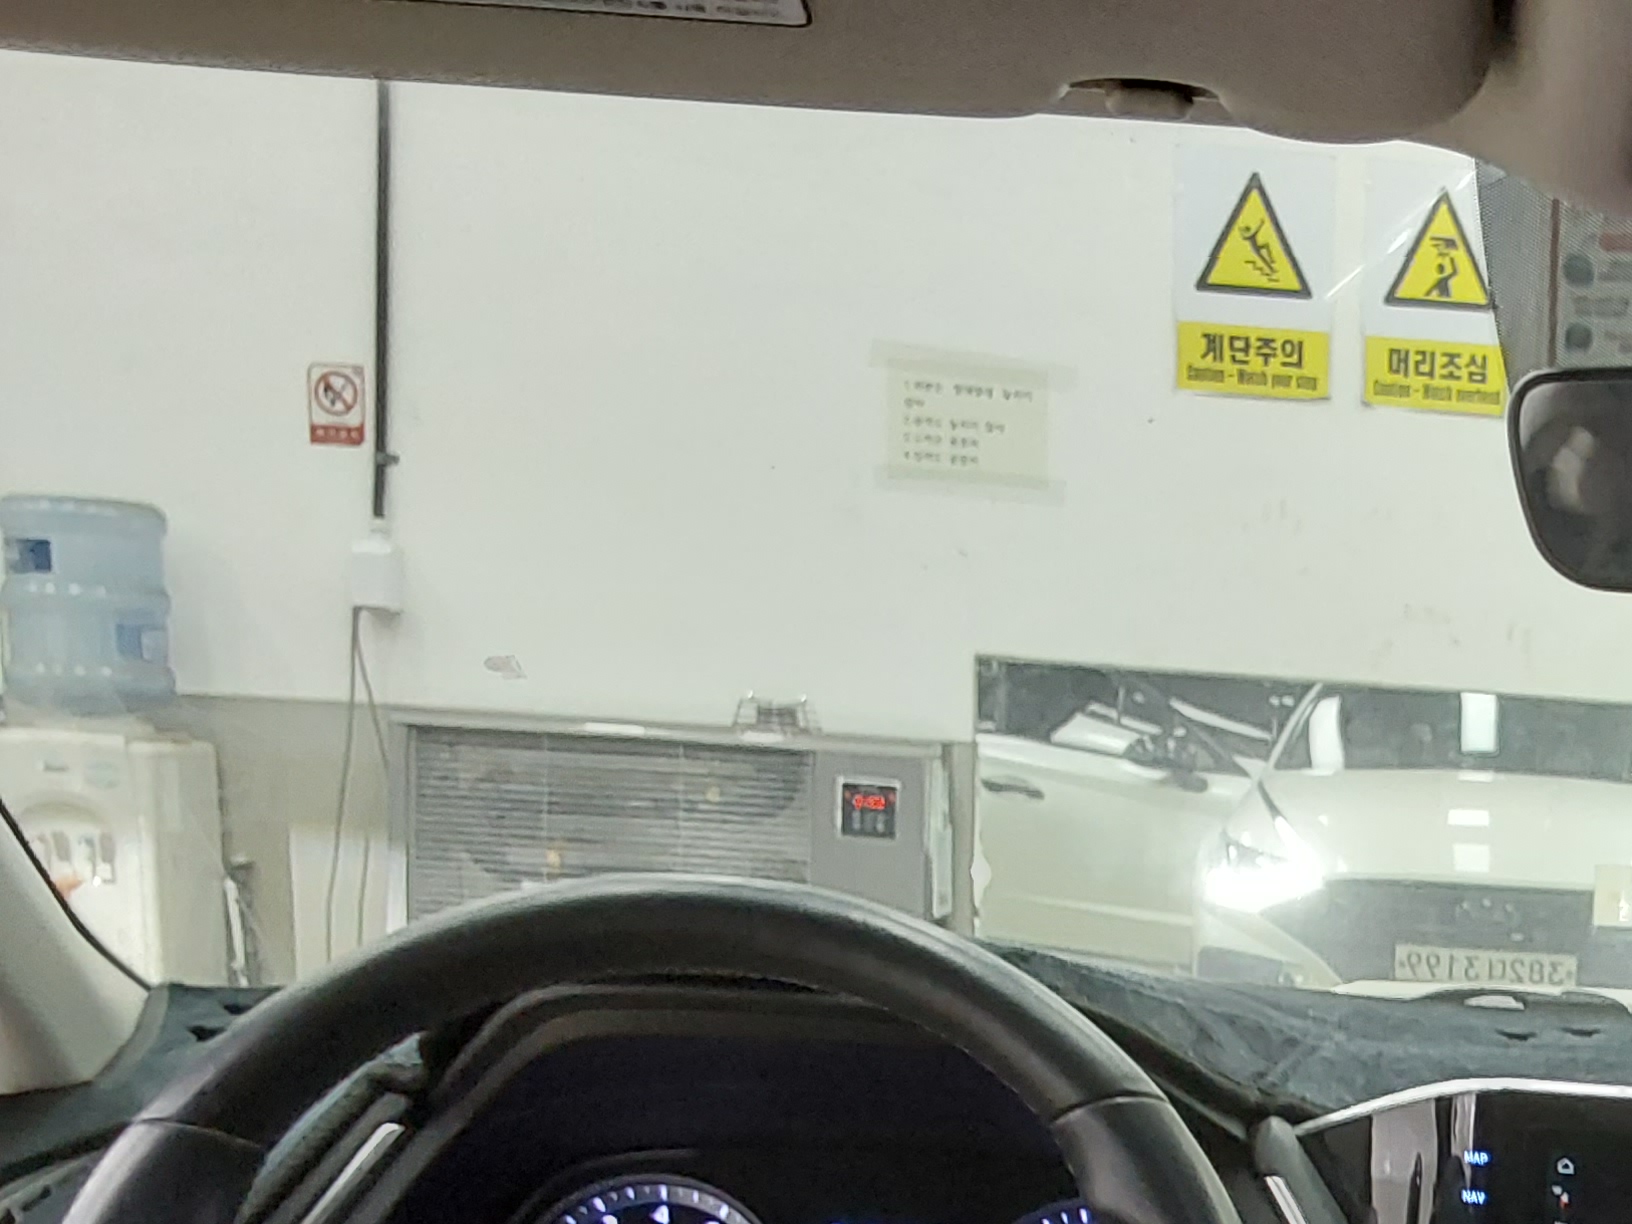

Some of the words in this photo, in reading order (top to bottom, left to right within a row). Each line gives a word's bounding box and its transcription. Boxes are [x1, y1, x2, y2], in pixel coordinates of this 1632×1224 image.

[1200, 333, 1304, 369] 계단주의
[1387, 348, 1489, 384] 머리조심
[1464, 1150, 1489, 1165] MAP
[1461, 1189, 1486, 1205] NAV
